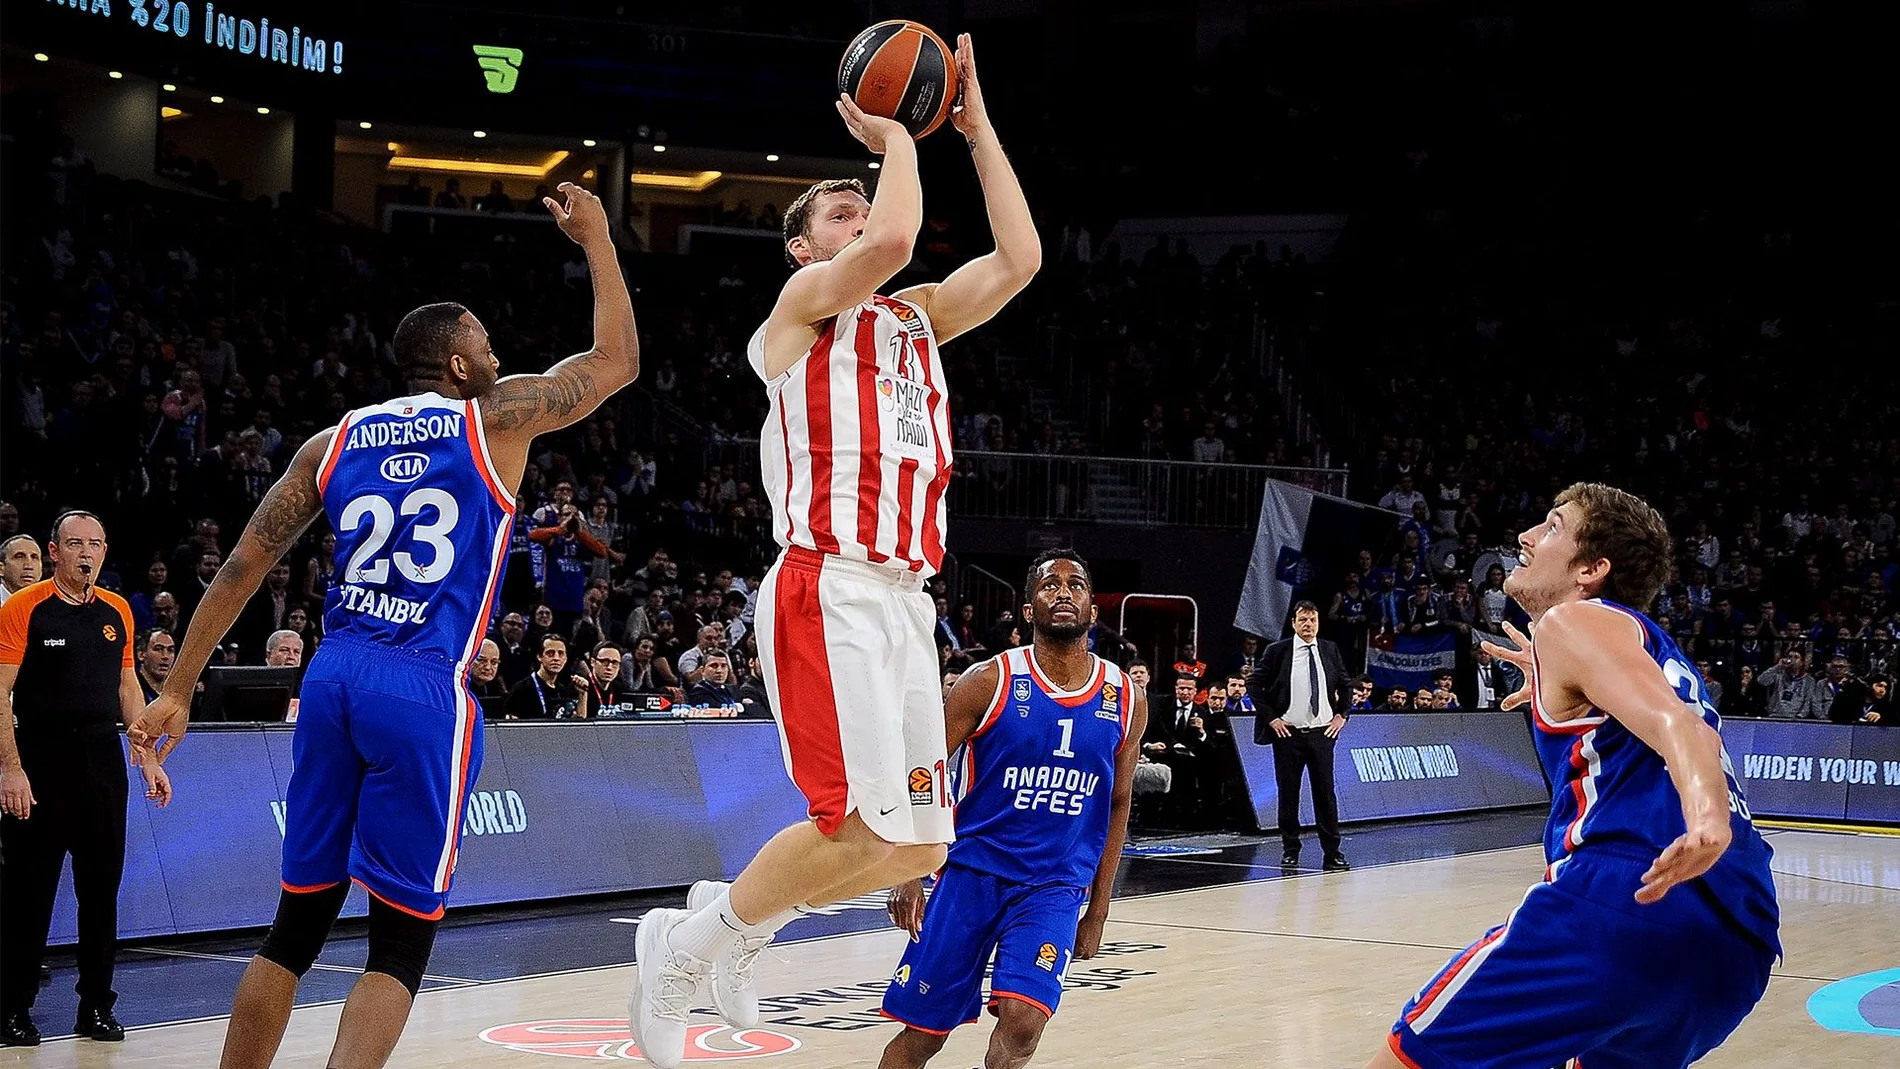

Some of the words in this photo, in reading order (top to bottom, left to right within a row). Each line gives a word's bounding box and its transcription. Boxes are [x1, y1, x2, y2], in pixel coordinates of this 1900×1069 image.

[346, 414, 461, 451] ANDERSON
[389, 458, 423, 477] KIA
[340, 488, 459, 585] 23
[1053, 719, 1075, 758] 1
[1002, 766, 1099, 796] ANADOLU
[1351, 747, 1395, 783] WIDEN
[1388, 746, 1425, 780] YOUR
[1416, 744, 1459, 779] WORLD
[1743, 754, 1814, 781] WIDEN
[1819, 757, 1877, 785] YOUR
[462, 789, 528, 837] ORLD
[1014, 789, 1084, 816] EFES
